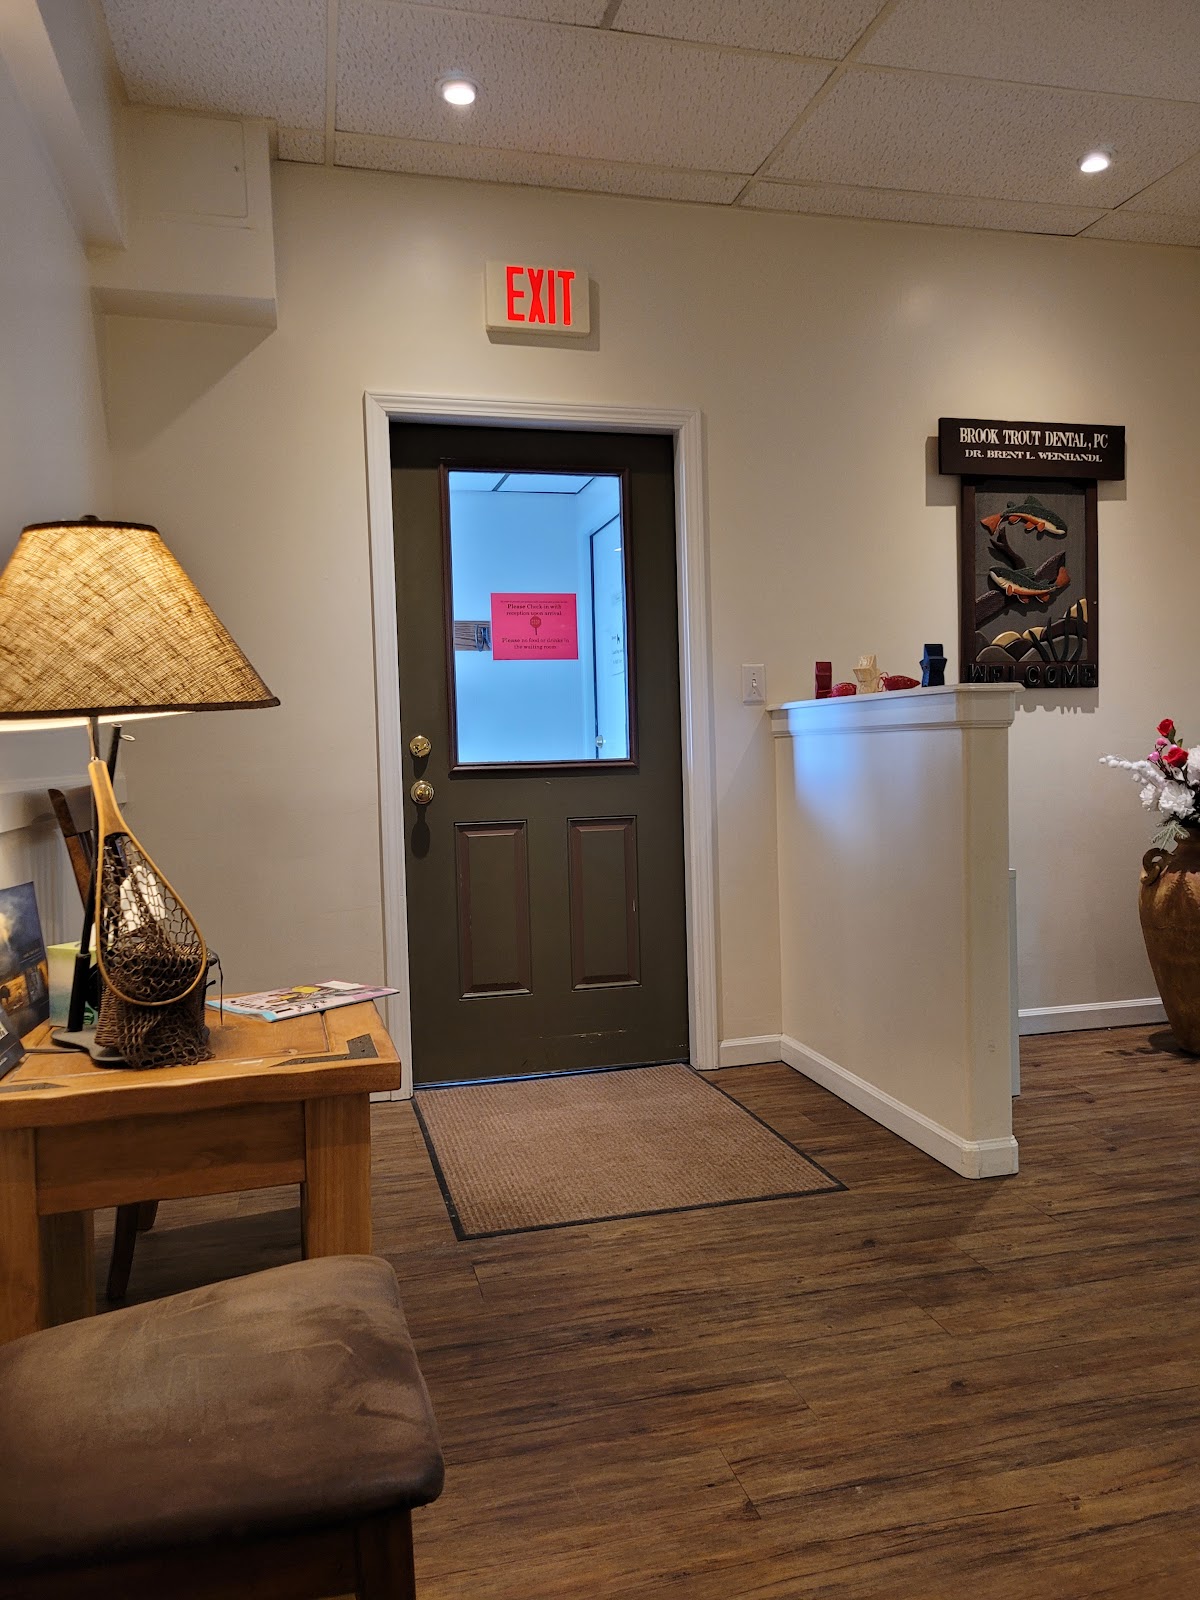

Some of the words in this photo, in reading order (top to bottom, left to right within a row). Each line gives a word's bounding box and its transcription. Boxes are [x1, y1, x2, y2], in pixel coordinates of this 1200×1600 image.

[506, 266, 575, 326] EXIT
[959, 427, 1000, 445] BROOK
[1002, 429, 1041, 447] TROUT
[965, 449, 985, 459] DR.
[987, 450, 1024, 460] BRENT
[1026, 451, 1036, 461] L.
[1038, 451, 1103, 463] WEINHANDL
[967, 662, 1097, 685] WELCOME
